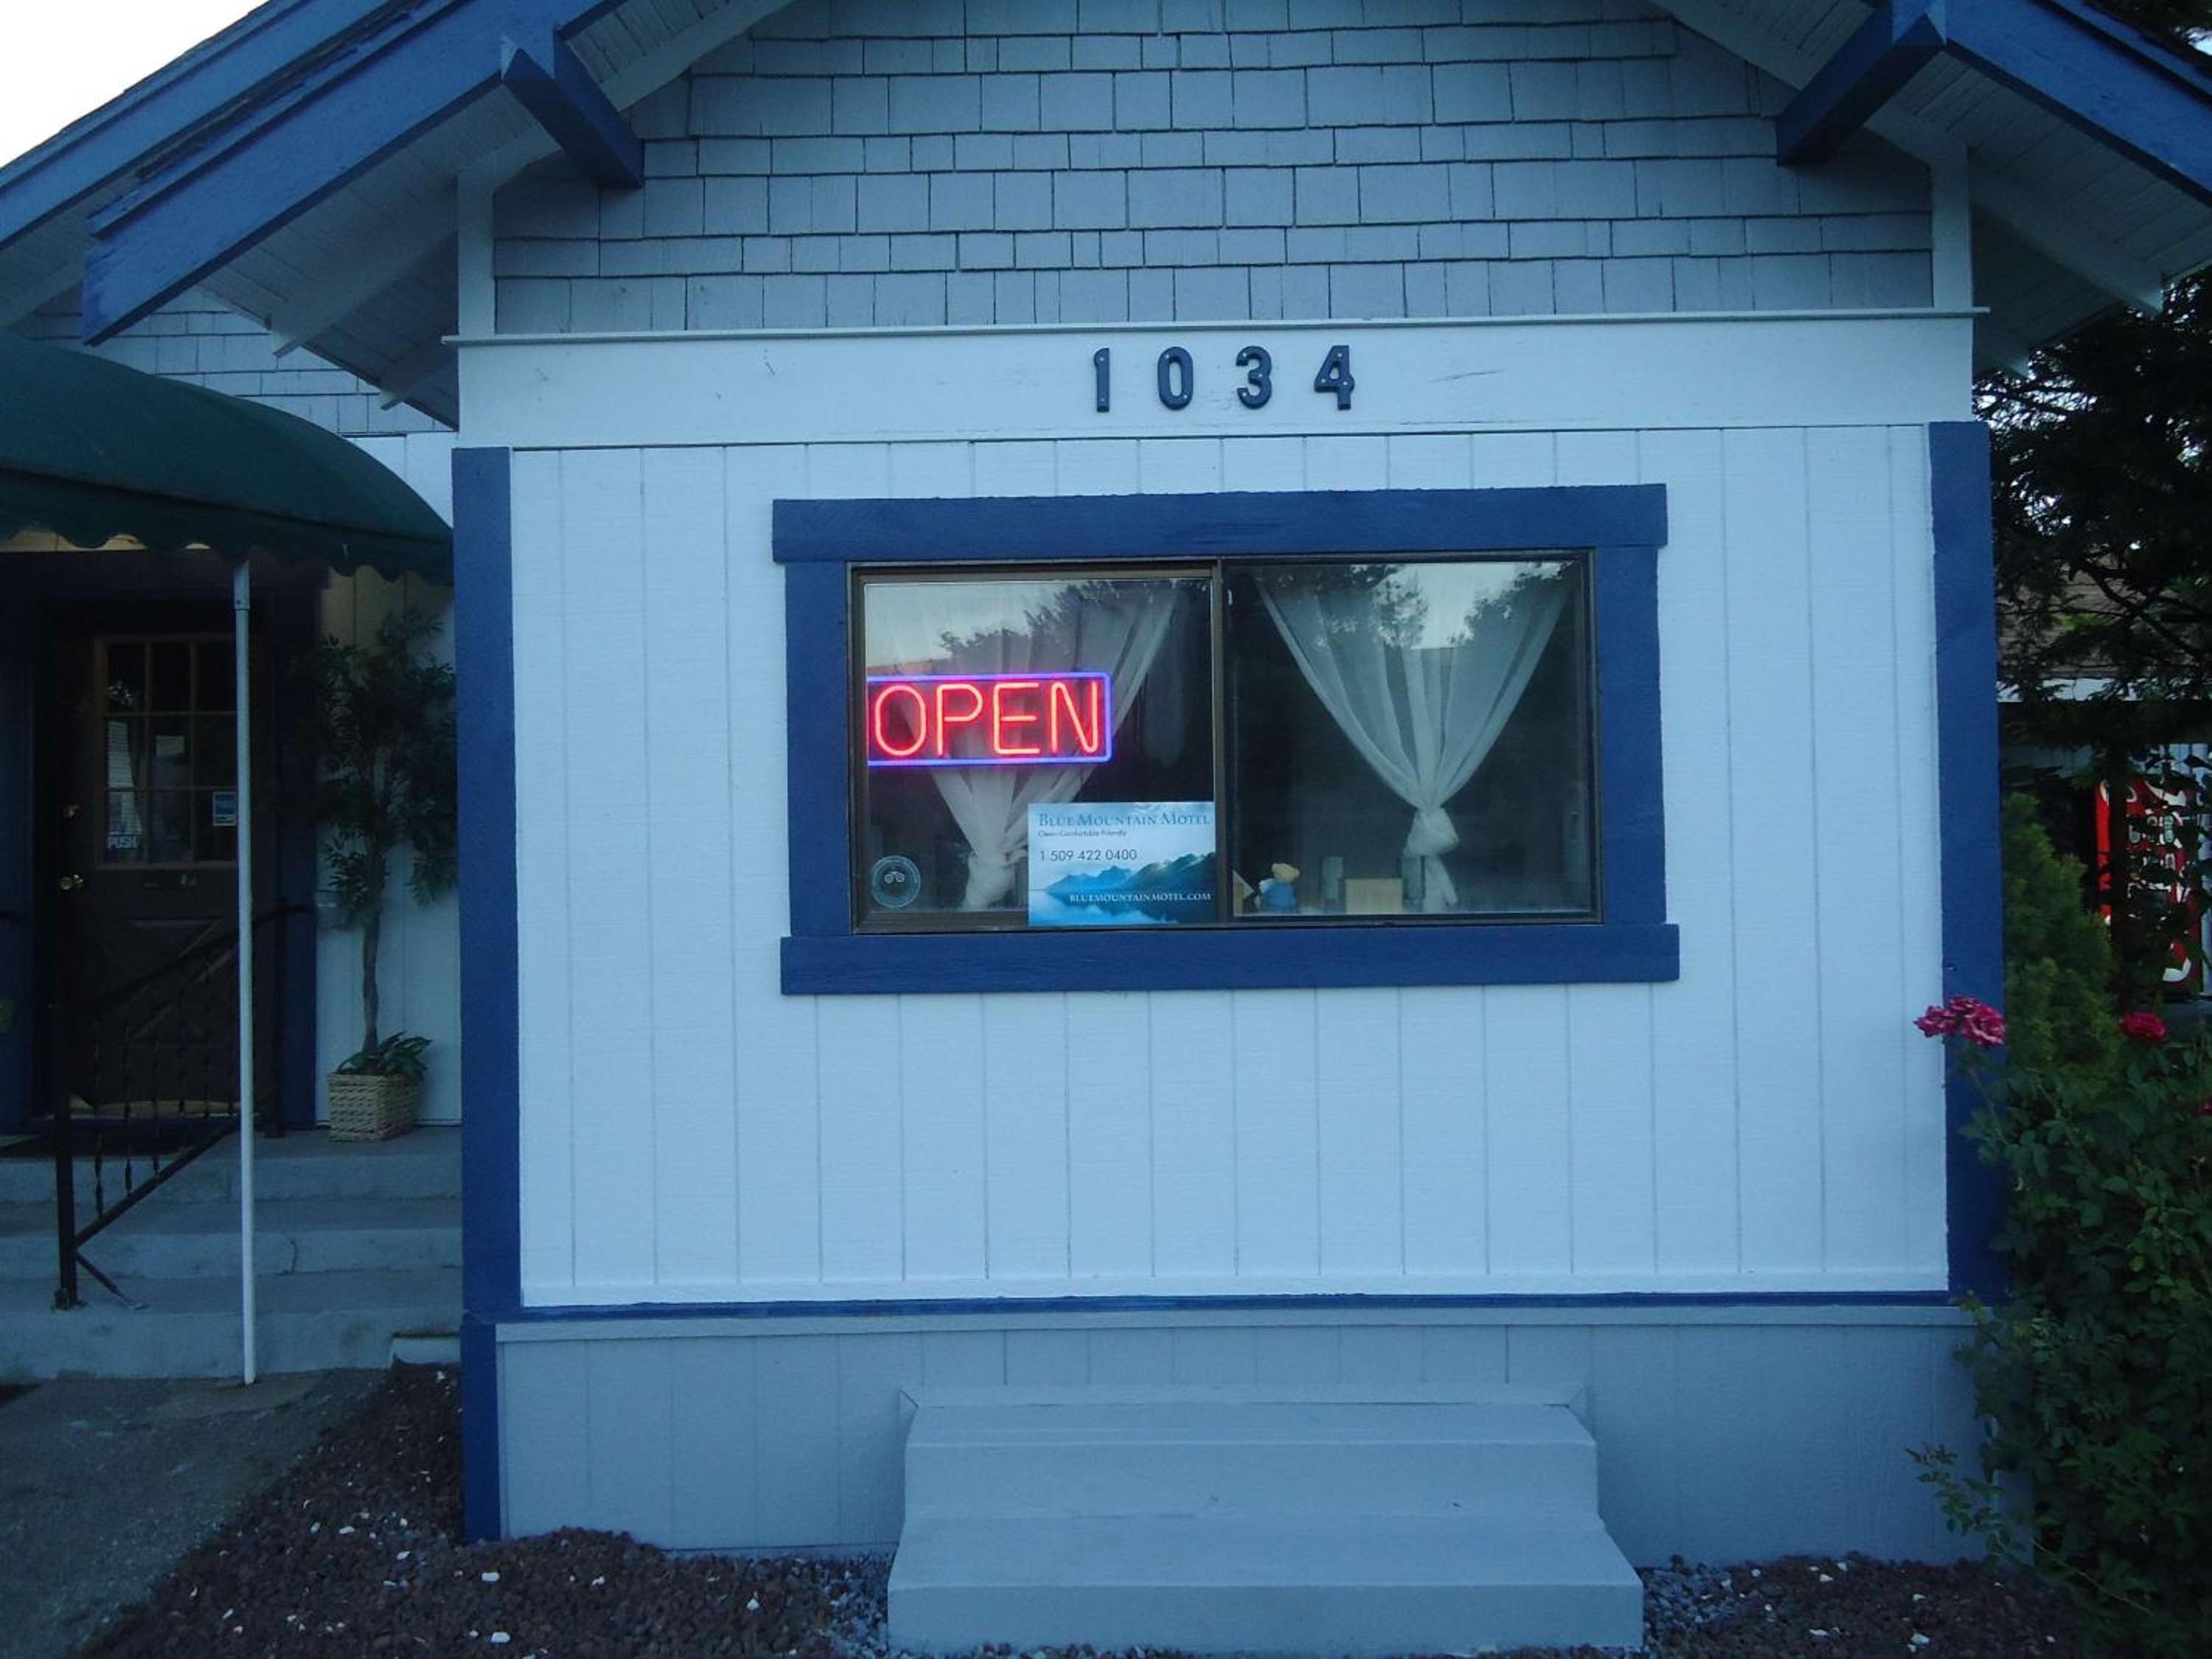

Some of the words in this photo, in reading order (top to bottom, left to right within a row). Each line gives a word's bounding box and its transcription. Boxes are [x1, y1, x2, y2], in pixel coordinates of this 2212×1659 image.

[1093, 345, 1355, 413] 1034
[874, 681, 1099, 757] OPEN
[1038, 813, 1074, 826] BLUE
[1077, 813, 1156, 826] MOUNTAIN
[1161, 813, 1209, 825] MOTEL
[108, 836, 139, 849] PUSH
[1040, 850, 1046, 861] 1
[1050, 850, 1074, 861] 509
[1078, 849, 1101, 860] 422
[1105, 849, 1138, 860] 0400
